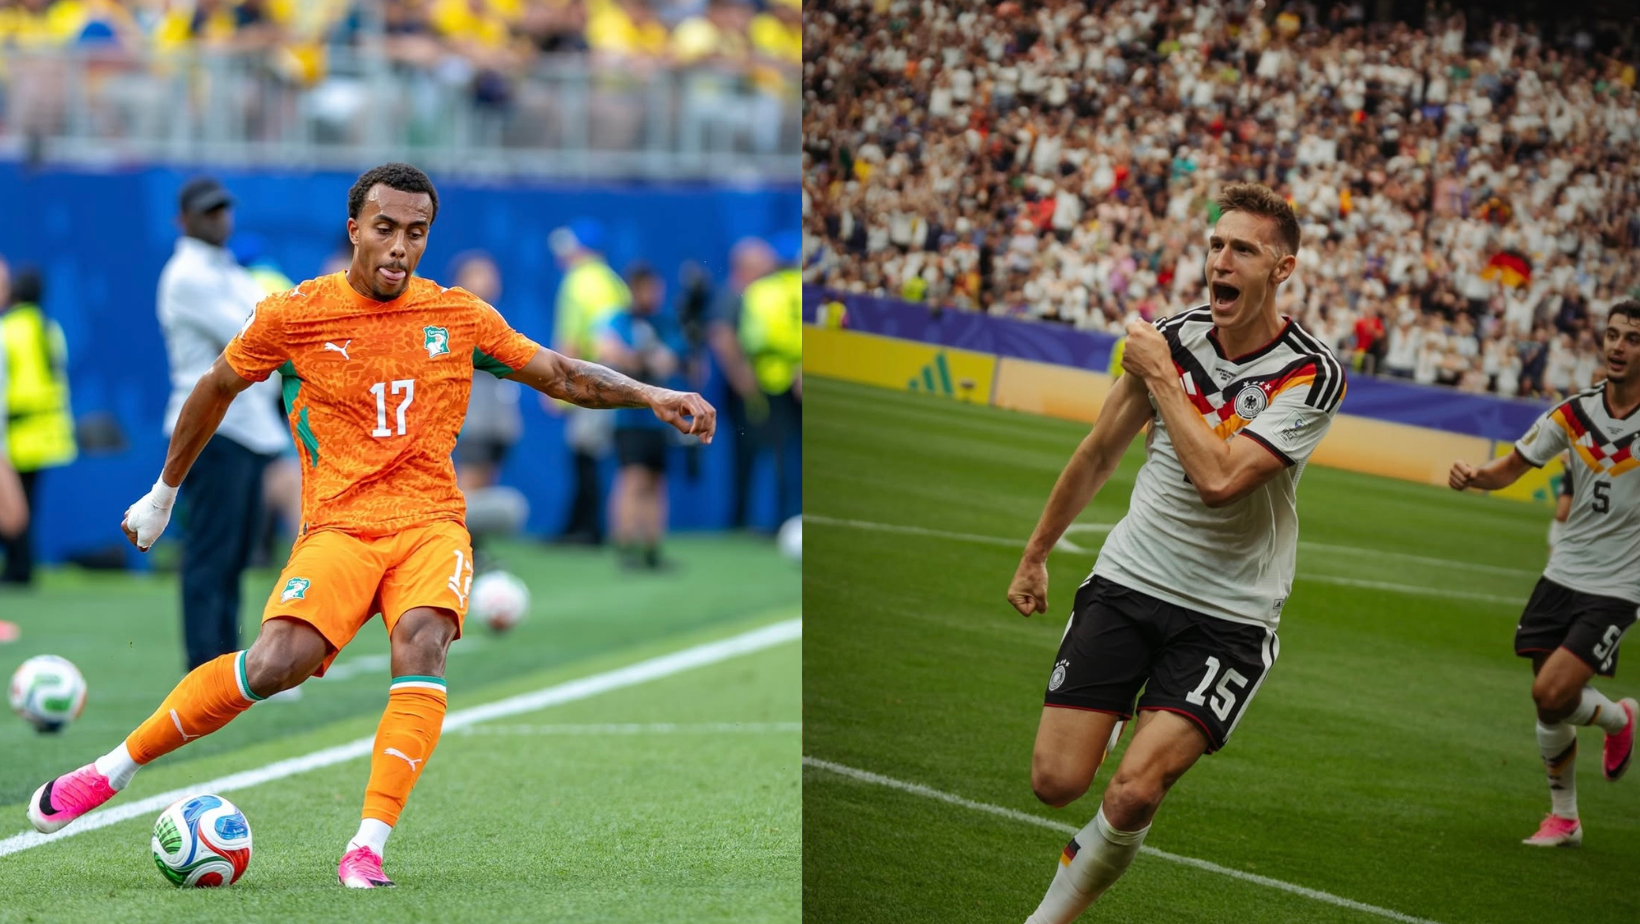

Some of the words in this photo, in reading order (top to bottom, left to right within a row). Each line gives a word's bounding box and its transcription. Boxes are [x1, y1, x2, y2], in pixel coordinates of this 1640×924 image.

[369, 379, 415, 437] 17
[1592, 480, 1611, 514] 5
[1594, 625, 1621, 660] 5
[1185, 656, 1249, 722] 15
